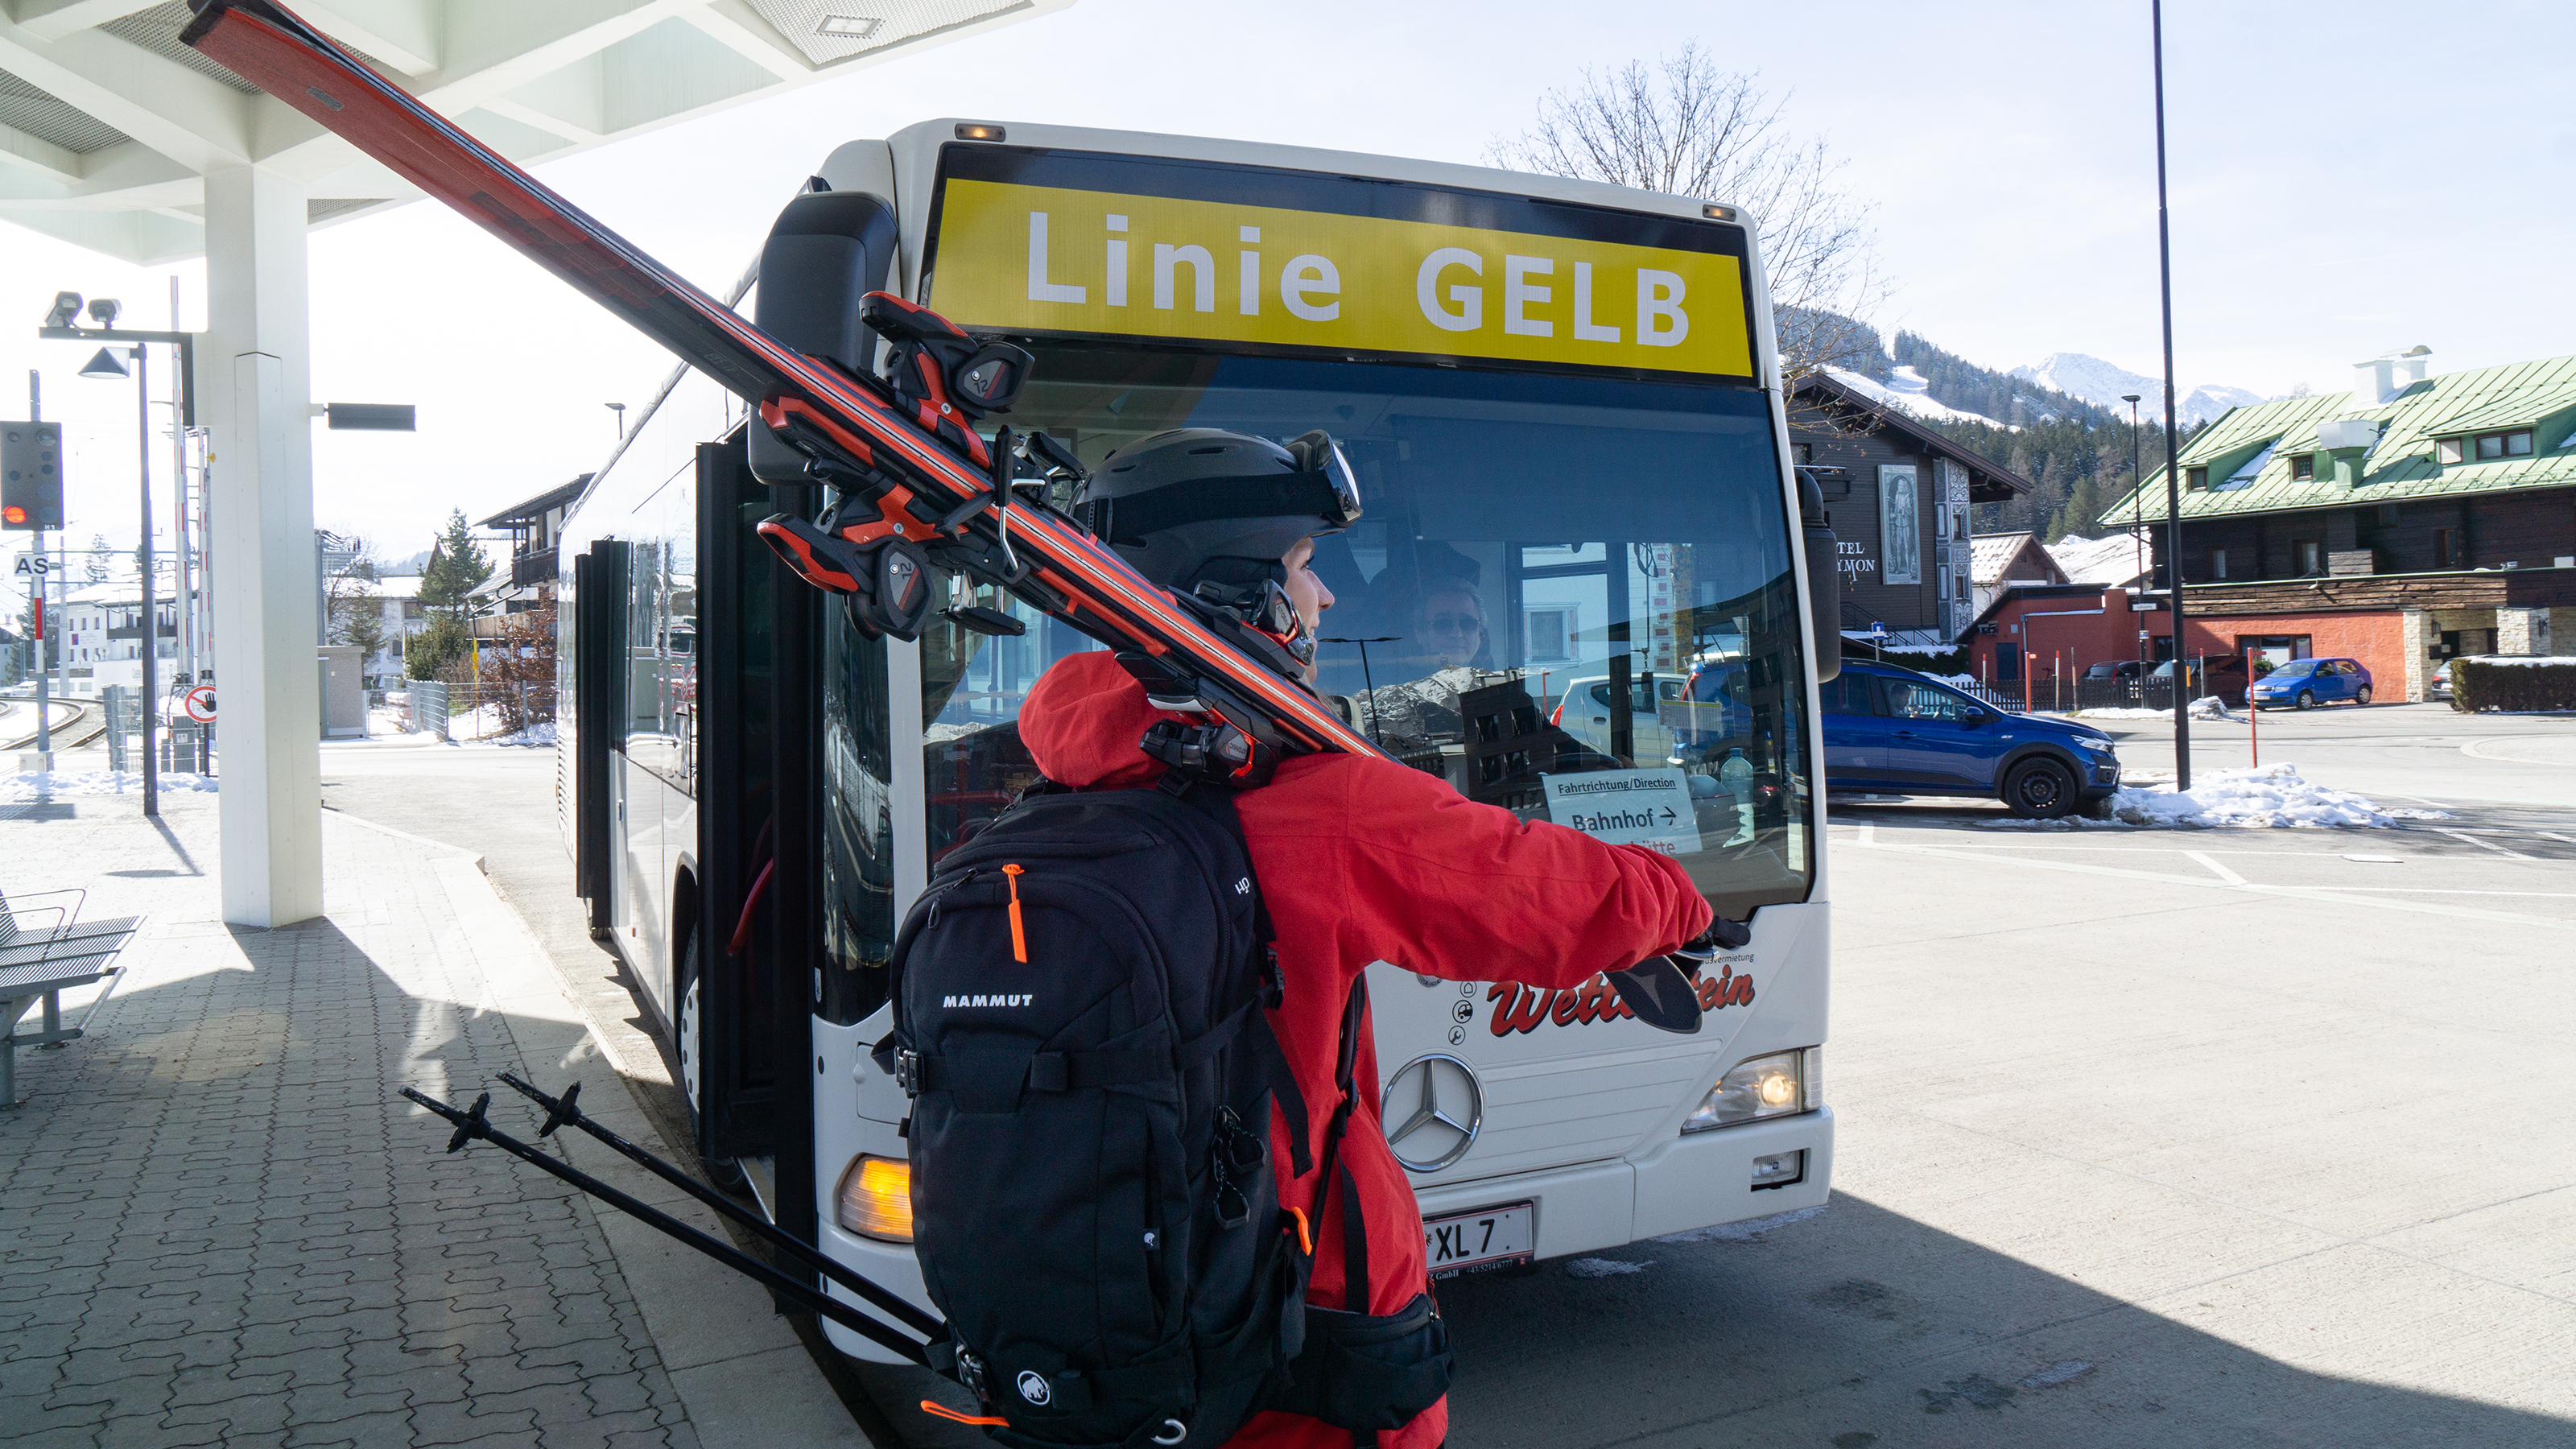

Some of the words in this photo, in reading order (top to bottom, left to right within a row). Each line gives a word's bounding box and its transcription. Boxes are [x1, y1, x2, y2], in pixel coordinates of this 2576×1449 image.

[1027, 211, 1341, 321] Linie
[1417, 247, 1689, 347] GELB
[974, 379, 989, 394] 12
[1836, 542, 1865, 554] TEL
[14, 558, 48, 574] AS
[1837, 559, 1876, 581] YMON
[1558, 778, 1676, 794] Fahrtrichtung/Direction
[1572, 808, 1653, 832] Bahnhof
[943, 994, 1033, 1008] MAMMUT
[1435, 1224, 1470, 1261] XL
[1479, 1218, 1495, 1253] 7
[1435, 1269, 1459, 1280] GmbH
